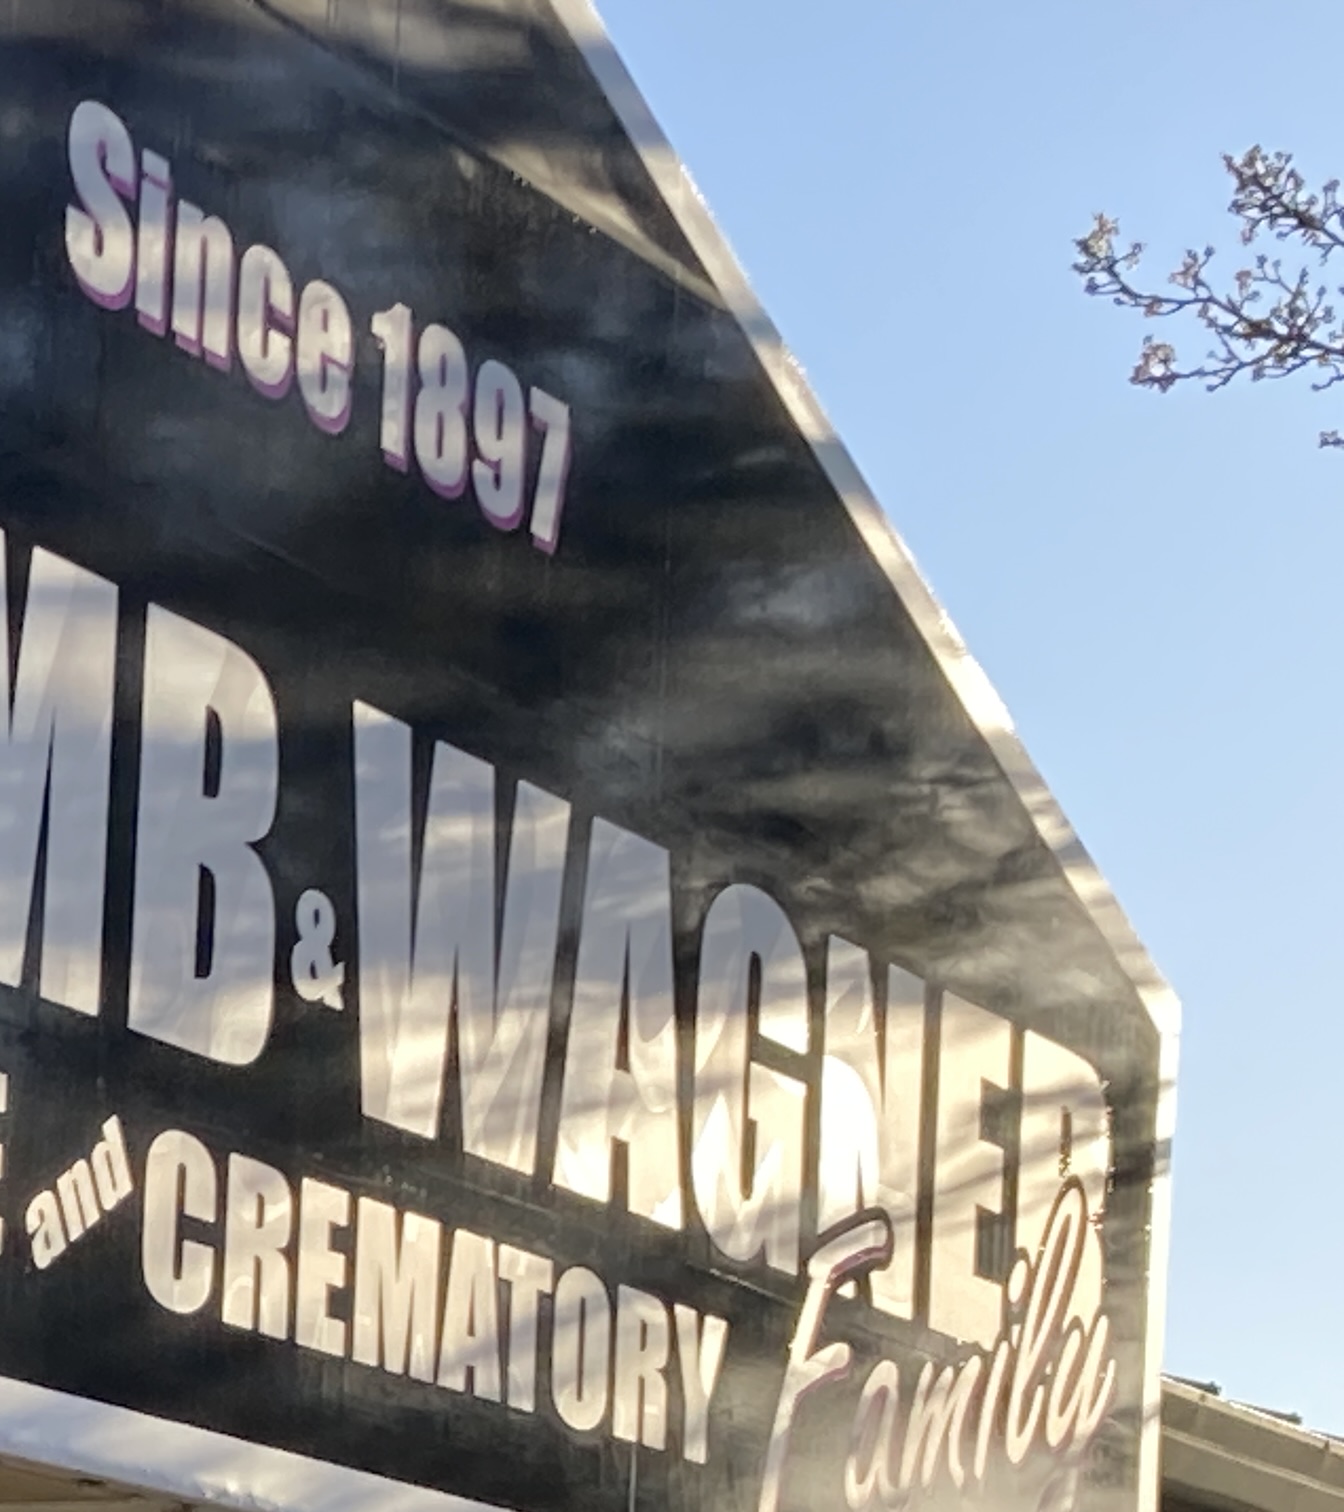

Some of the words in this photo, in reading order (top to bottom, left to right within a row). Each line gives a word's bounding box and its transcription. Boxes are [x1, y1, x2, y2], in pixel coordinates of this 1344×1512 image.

[65, 100, 354, 434] Since
[372, 302, 571, 555] 1897
[290, 887, 346, 1011] &
[353, 699, 1110, 1352] WAGNER
[25, 1114, 134, 1270] and
[141, 1130, 728, 1465] CREMATORY
